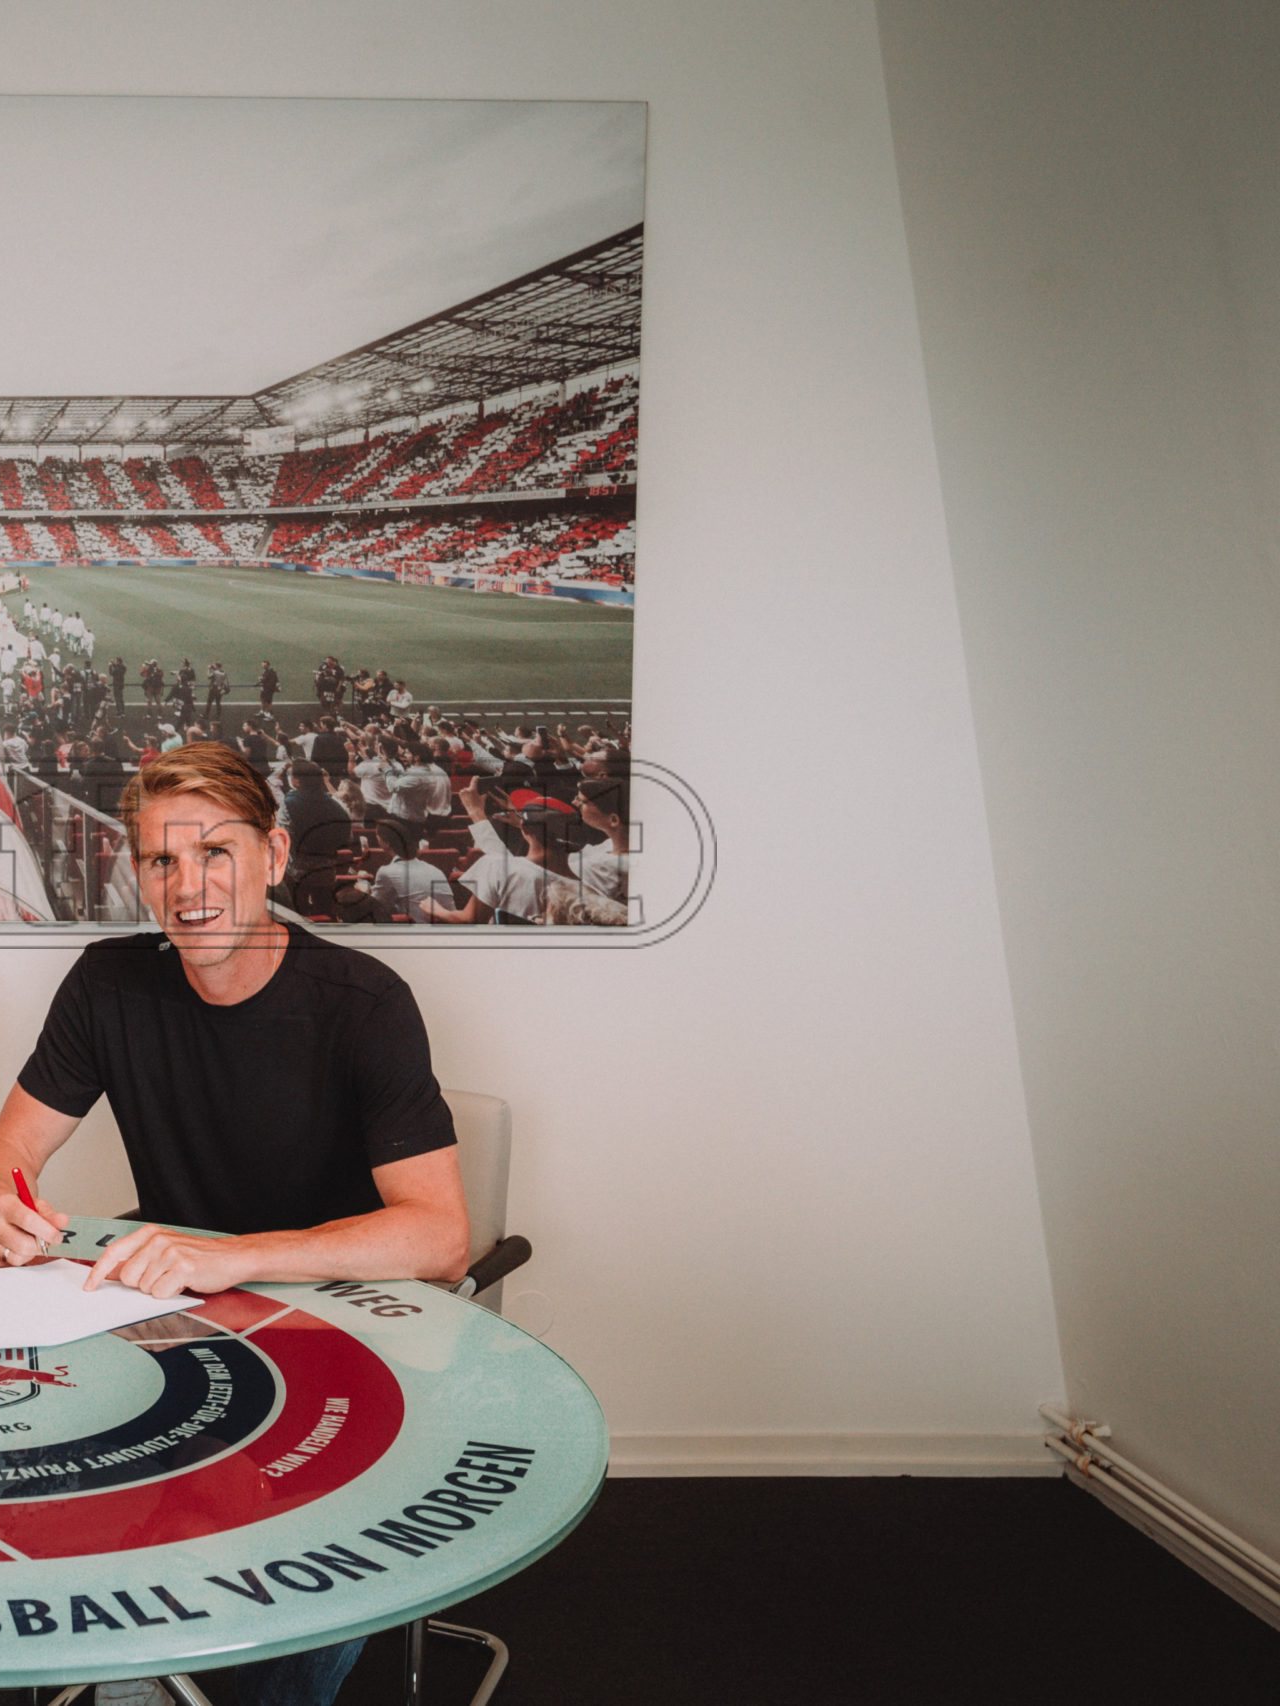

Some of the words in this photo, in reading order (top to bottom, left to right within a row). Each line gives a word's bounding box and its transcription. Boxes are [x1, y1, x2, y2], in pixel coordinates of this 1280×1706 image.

[313, 1280, 423, 1318] WEG
[188, 1348, 221, 1361] MIT
[203, 1363, 232, 1380] DEM
[324, 1397, 350, 1414] WIE
[294, 1414, 347, 1454] HANDELN
[259, 1453, 312, 1477] WIR?
[203, 1543, 390, 1606] VON
[359, 1441, 536, 1558] MORGEN
